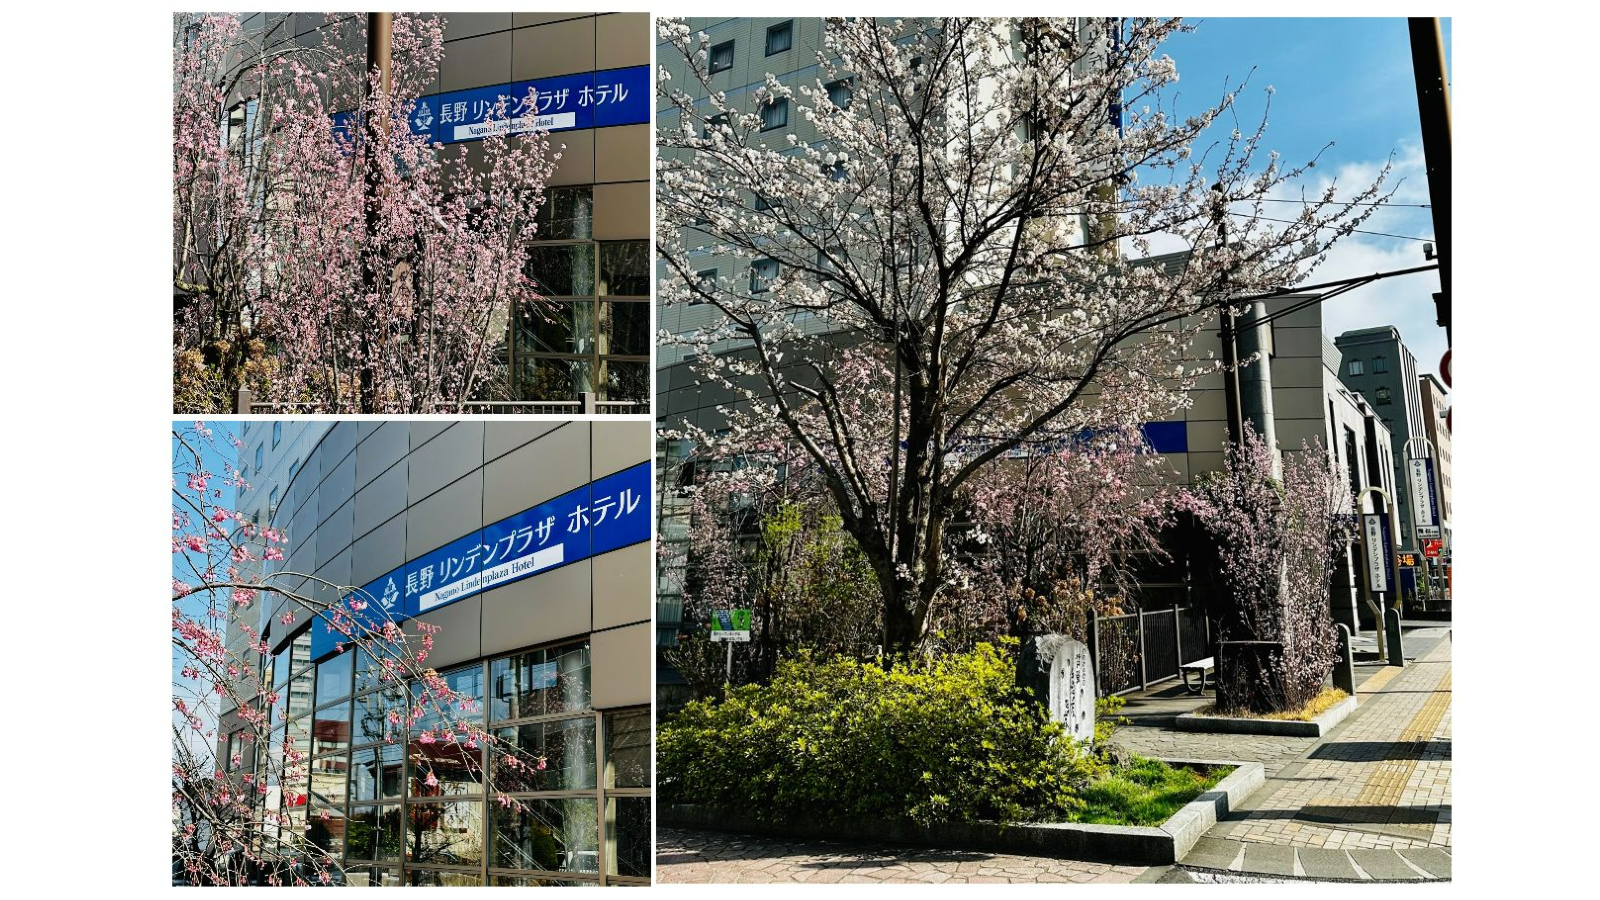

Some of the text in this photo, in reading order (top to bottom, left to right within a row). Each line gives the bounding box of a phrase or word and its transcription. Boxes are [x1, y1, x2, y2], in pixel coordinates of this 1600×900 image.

[440, 102, 468, 125] 長野
[578, 83, 629, 107] ホテル
[405, 488, 641, 598] 長野 リンデンプラザ ホテル
[434, 557, 535, 601] Nagano Lindenplaza Hotel
